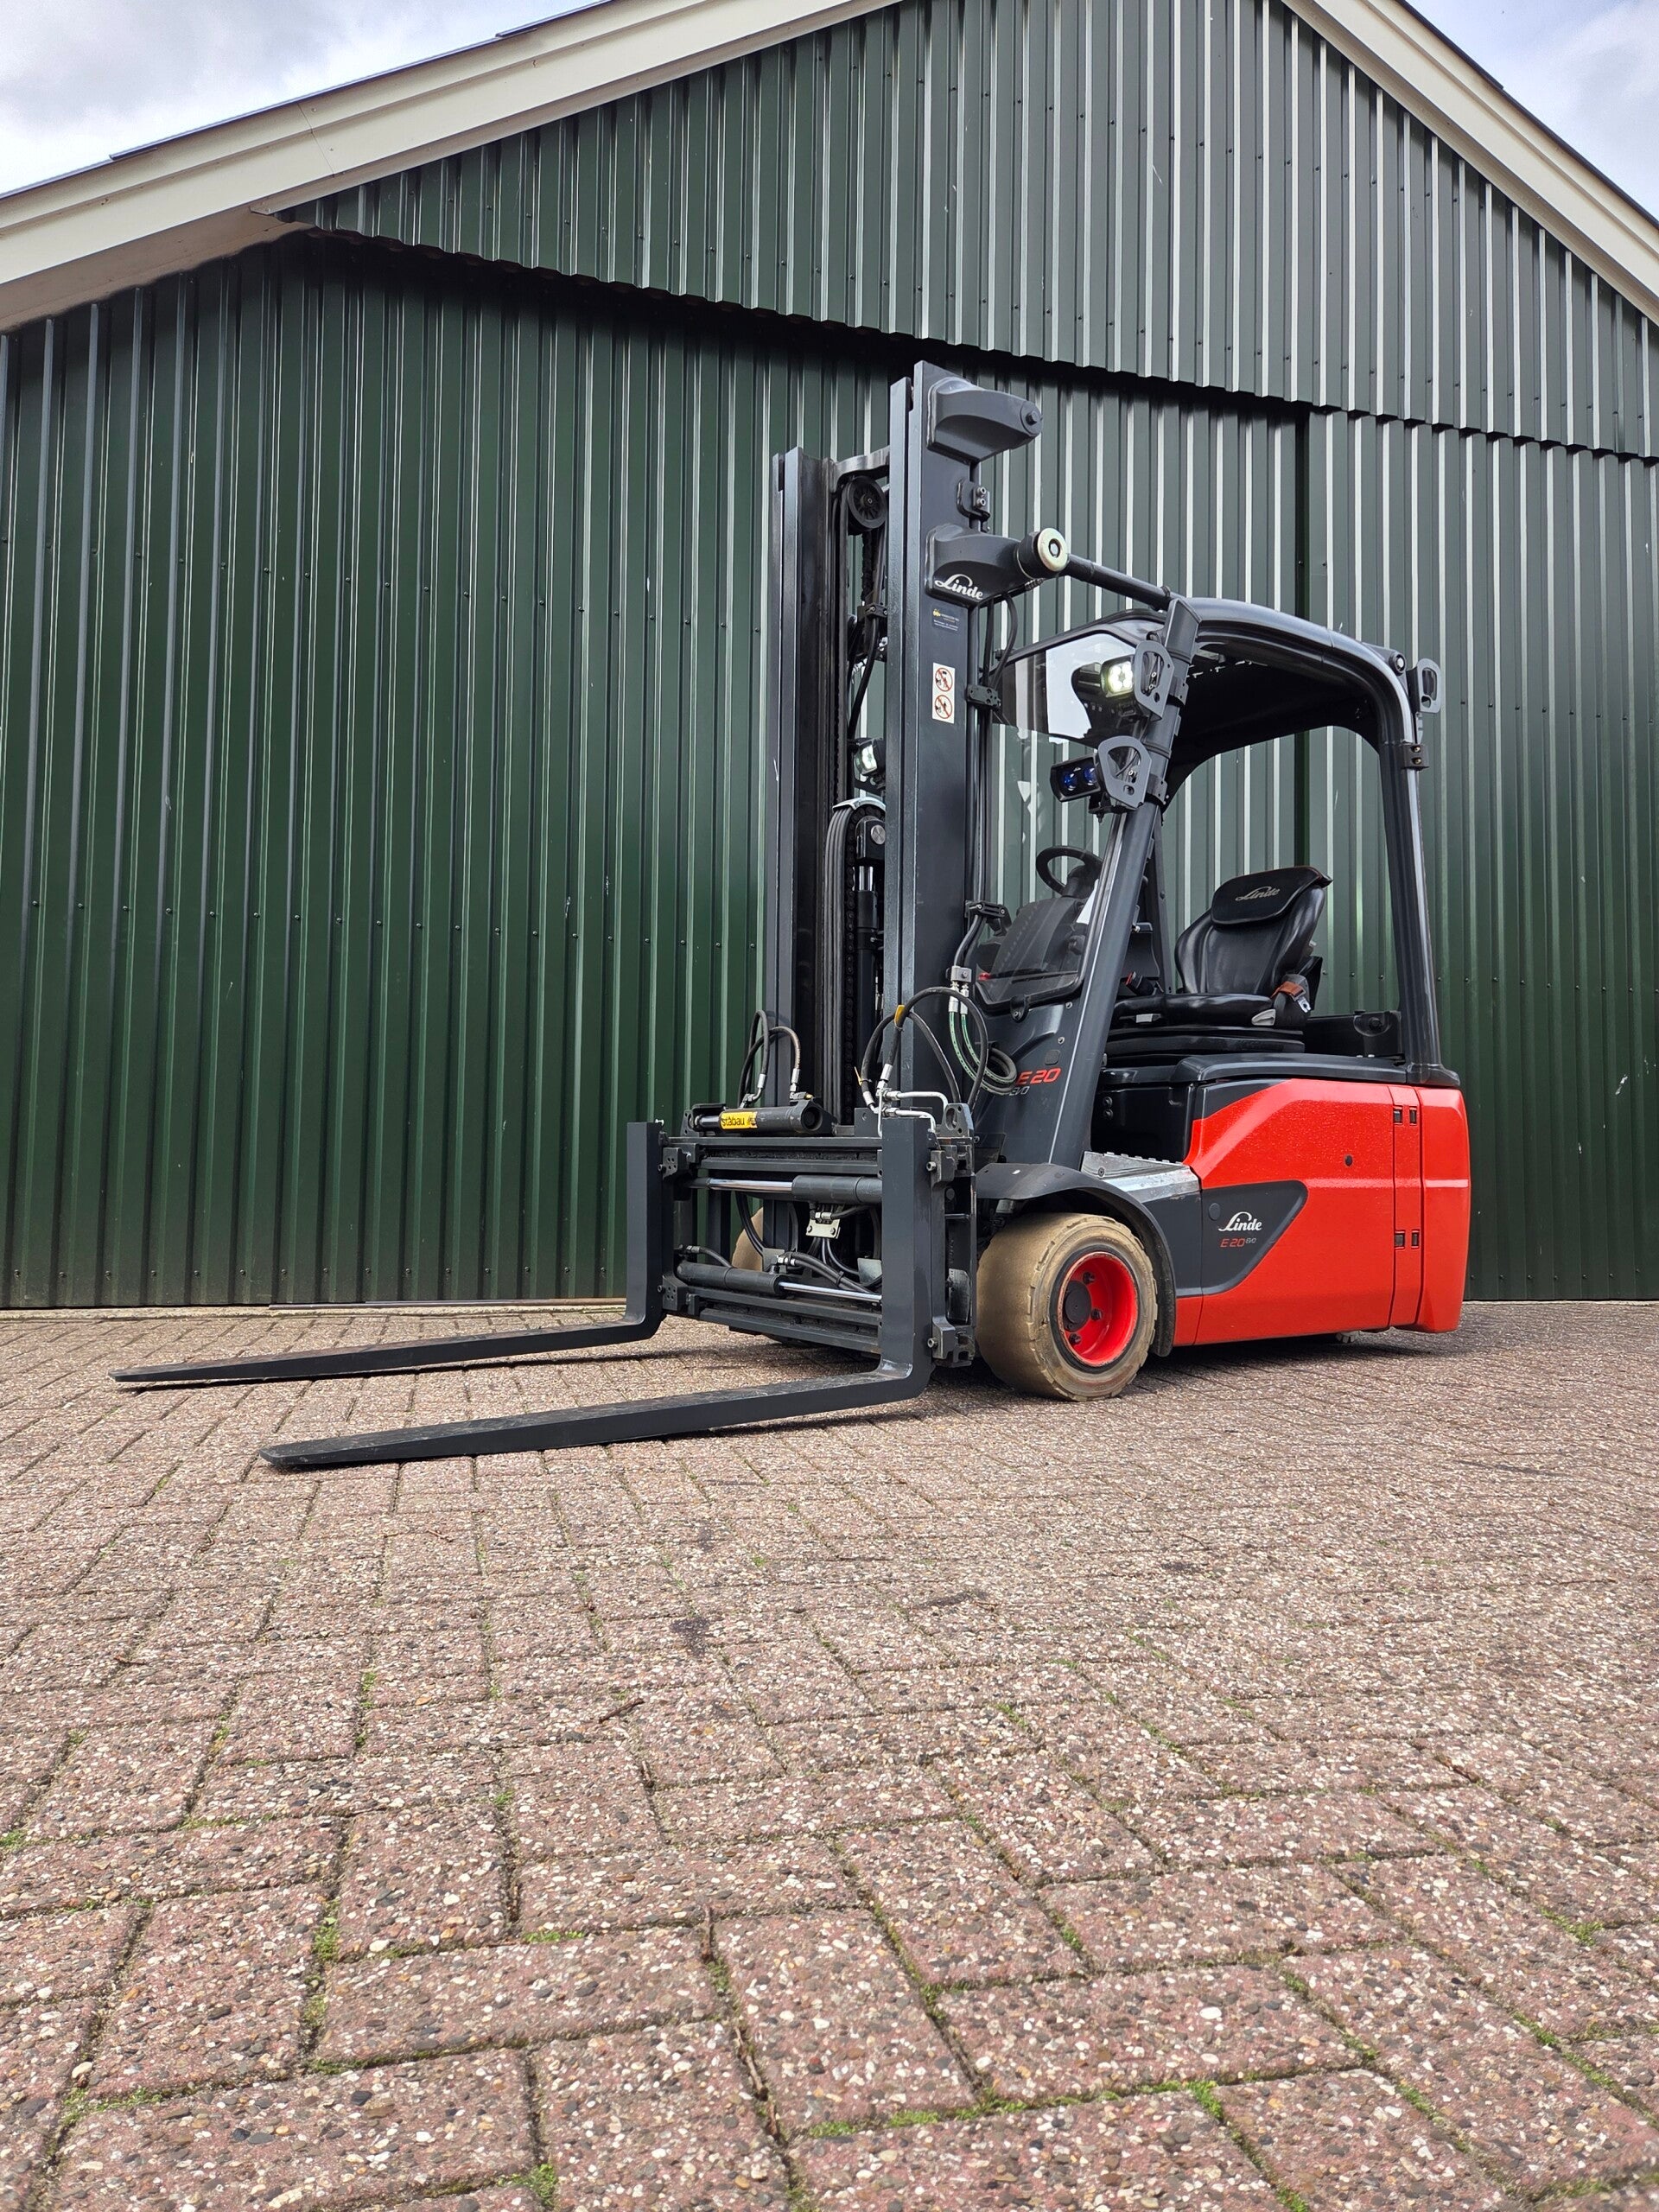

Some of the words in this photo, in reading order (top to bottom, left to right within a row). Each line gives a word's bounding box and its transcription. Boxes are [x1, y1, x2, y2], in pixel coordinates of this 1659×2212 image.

[934, 574, 983, 600] Linde
[1235, 886, 1281, 901] Linde
[1217, 1211, 1262, 1231] Linde
